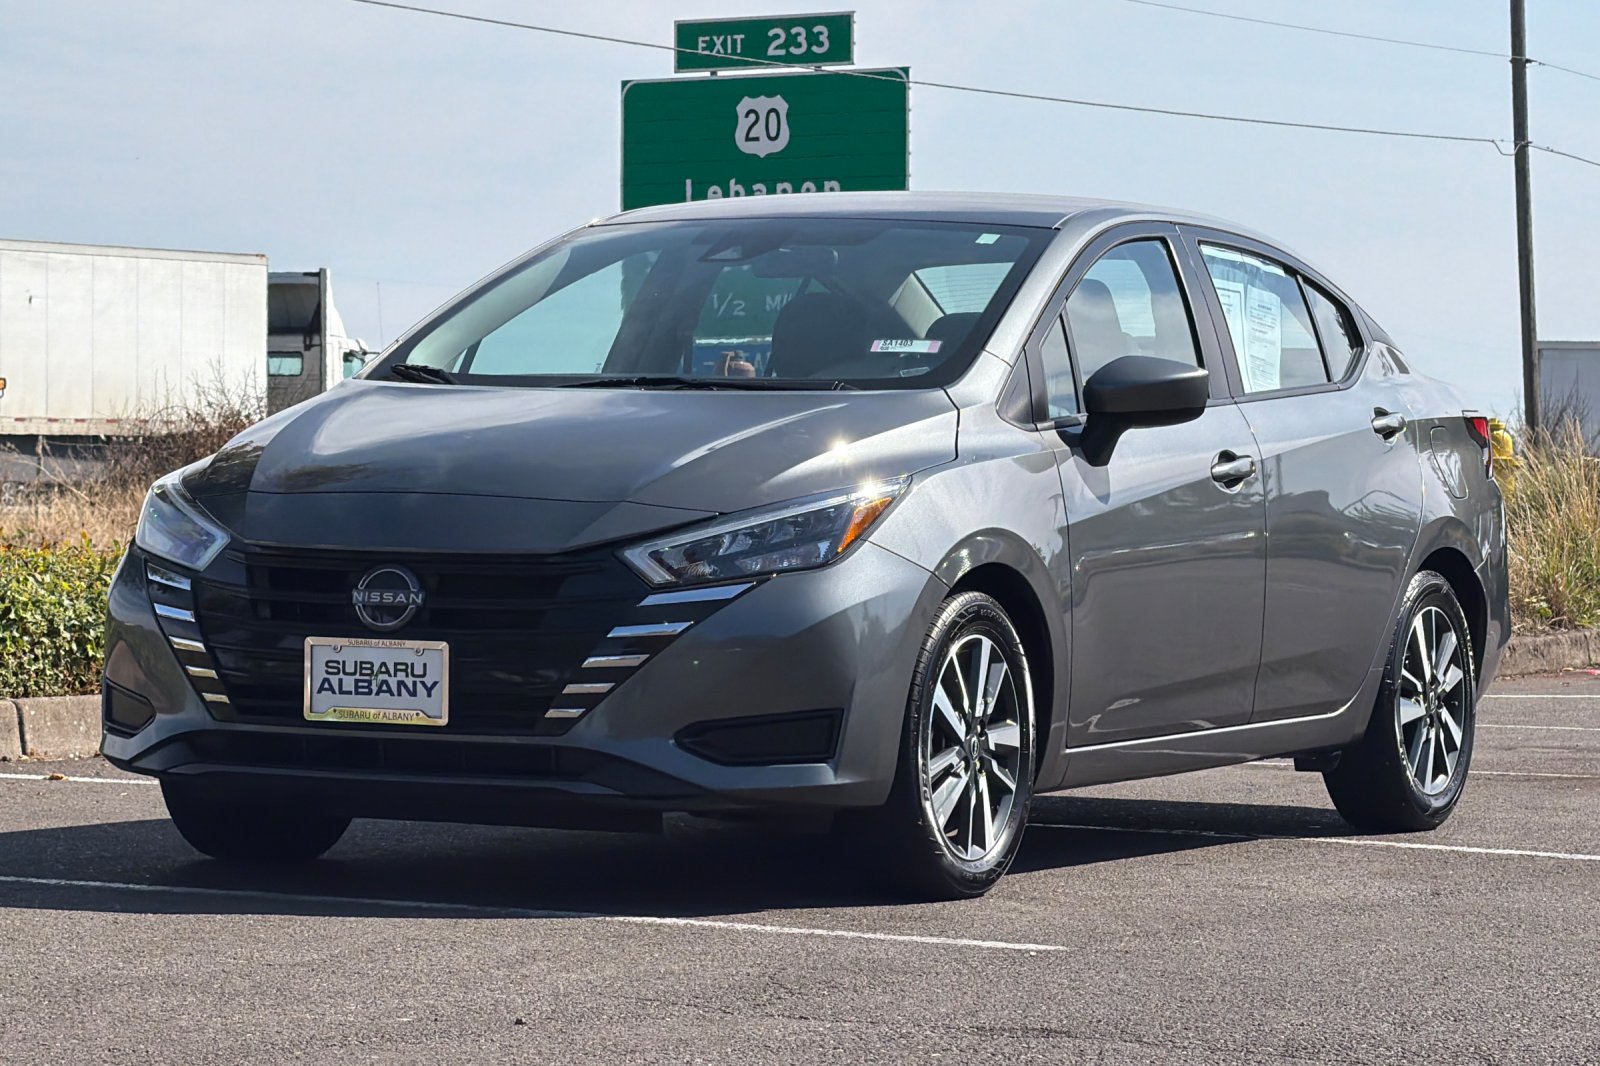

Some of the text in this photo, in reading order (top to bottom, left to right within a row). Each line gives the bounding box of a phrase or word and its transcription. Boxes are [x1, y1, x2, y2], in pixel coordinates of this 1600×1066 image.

[698, 25, 830, 56] EXIT 233
[744, 108, 781, 142] 20
[353, 592, 422, 604] NISSAN
[325, 660, 427, 678] SUBARU
[316, 677, 439, 698] ALBANY
[338, 709, 414, 722] SUBARU of ALBANY
